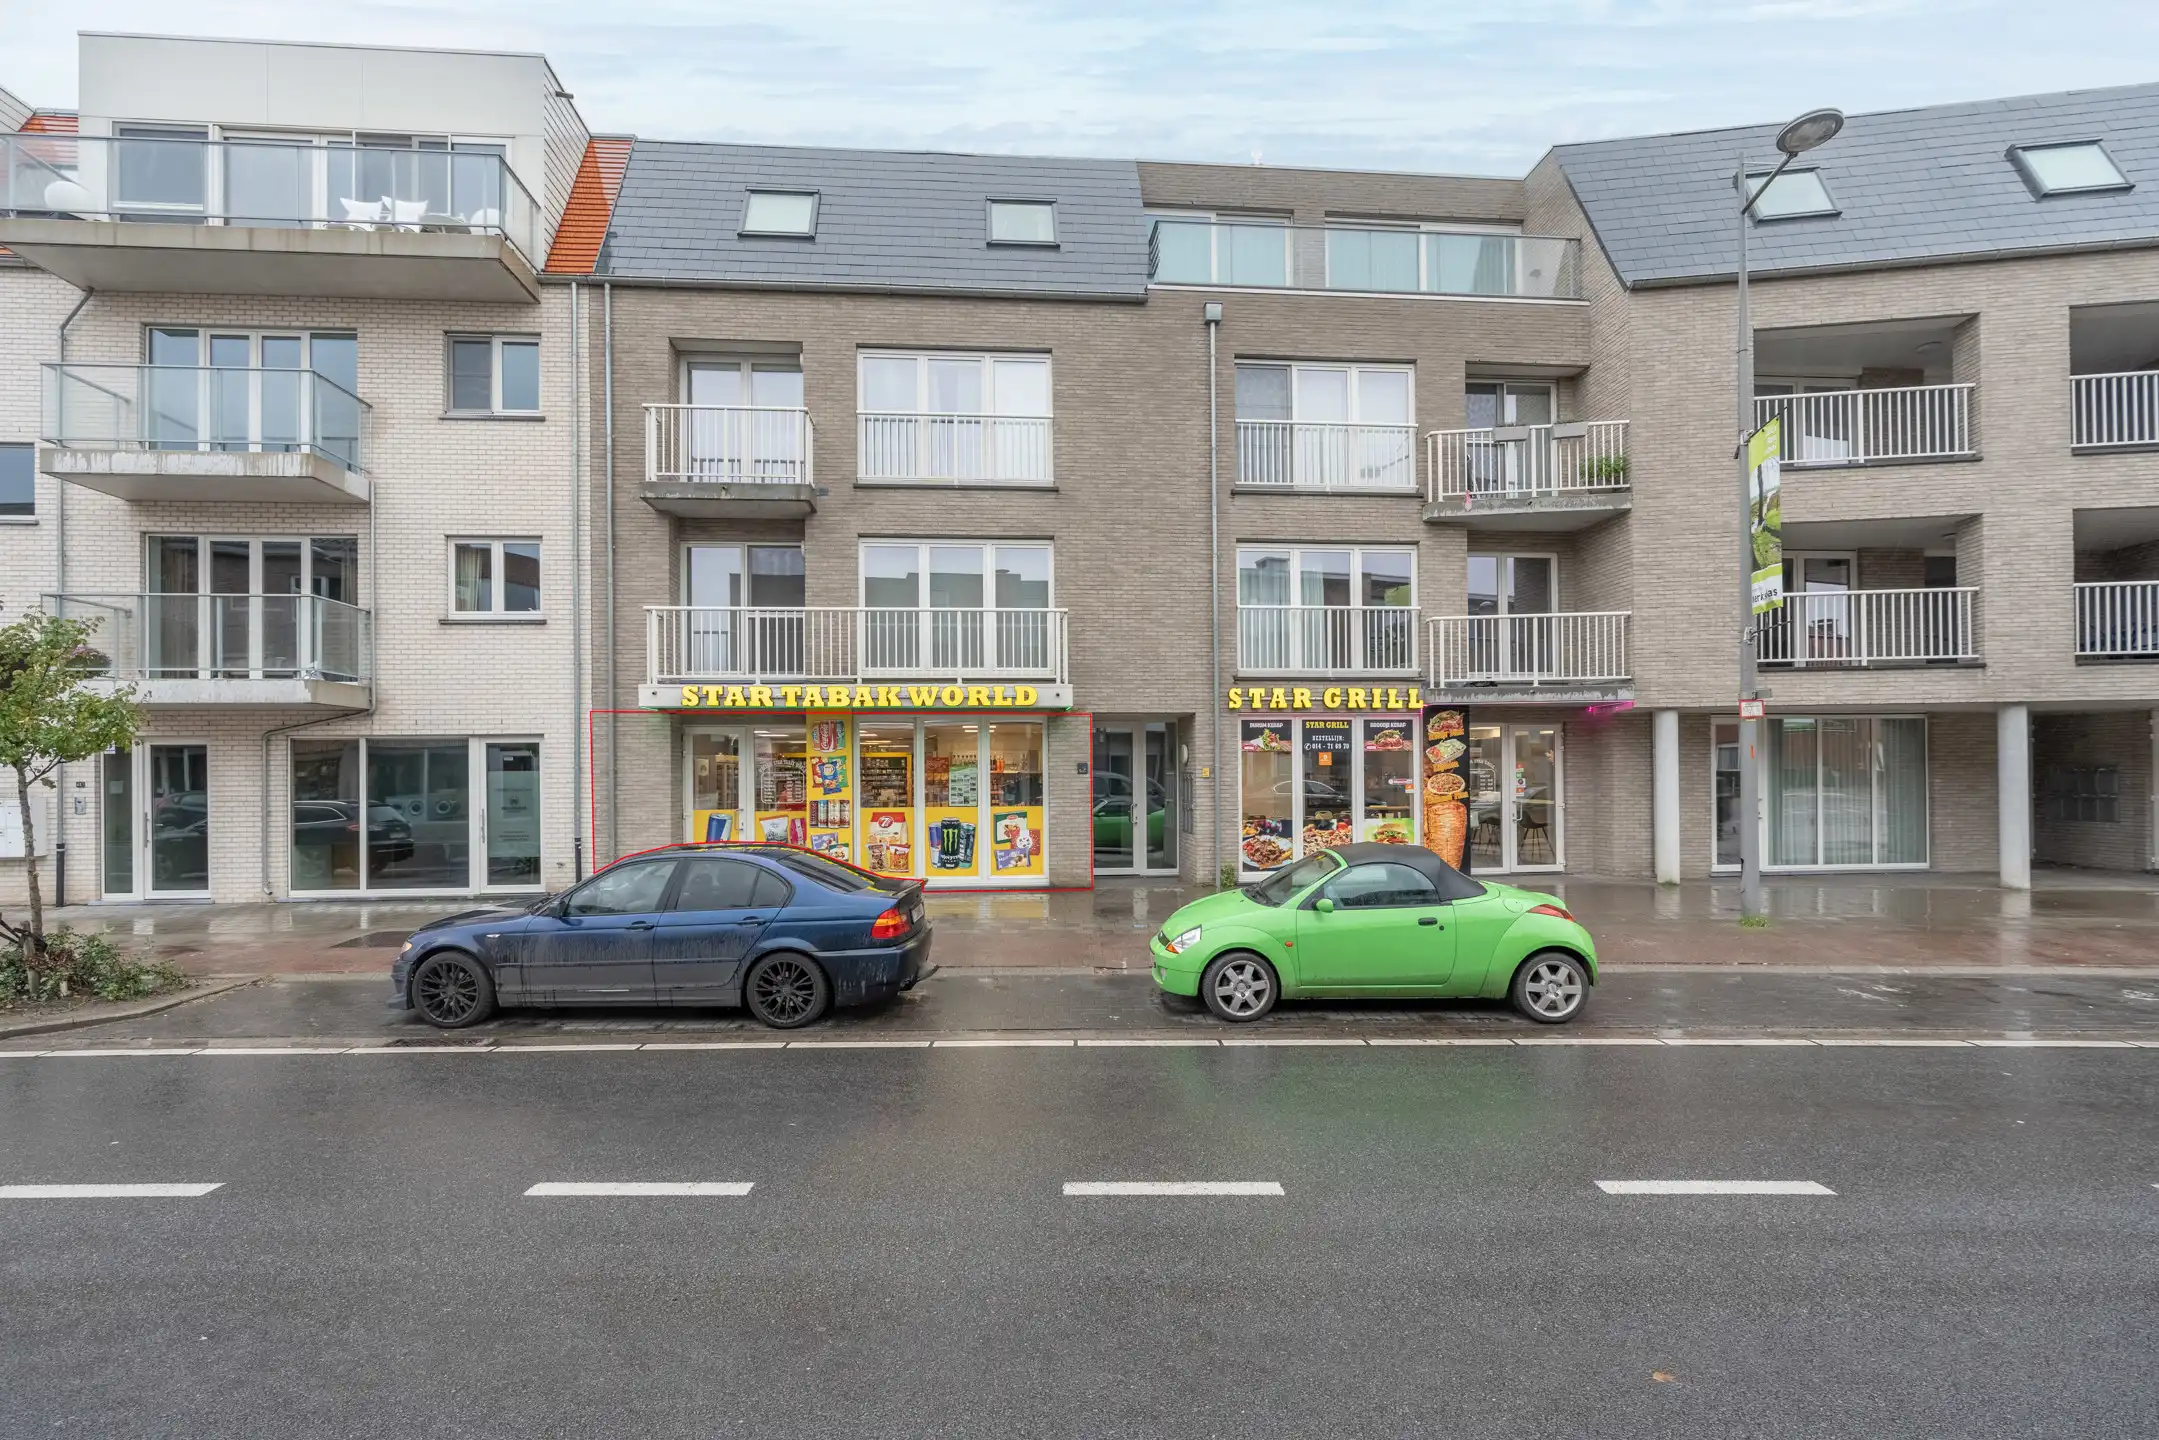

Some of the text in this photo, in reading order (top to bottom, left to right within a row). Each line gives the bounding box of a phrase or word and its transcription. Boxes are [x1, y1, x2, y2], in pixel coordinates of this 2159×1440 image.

[681, 685, 1038, 707] STAR TABAK WORLD
[1228, 687, 1424, 709] STAR GRILL
[1305, 721, 1349, 729] STAR GRILL
